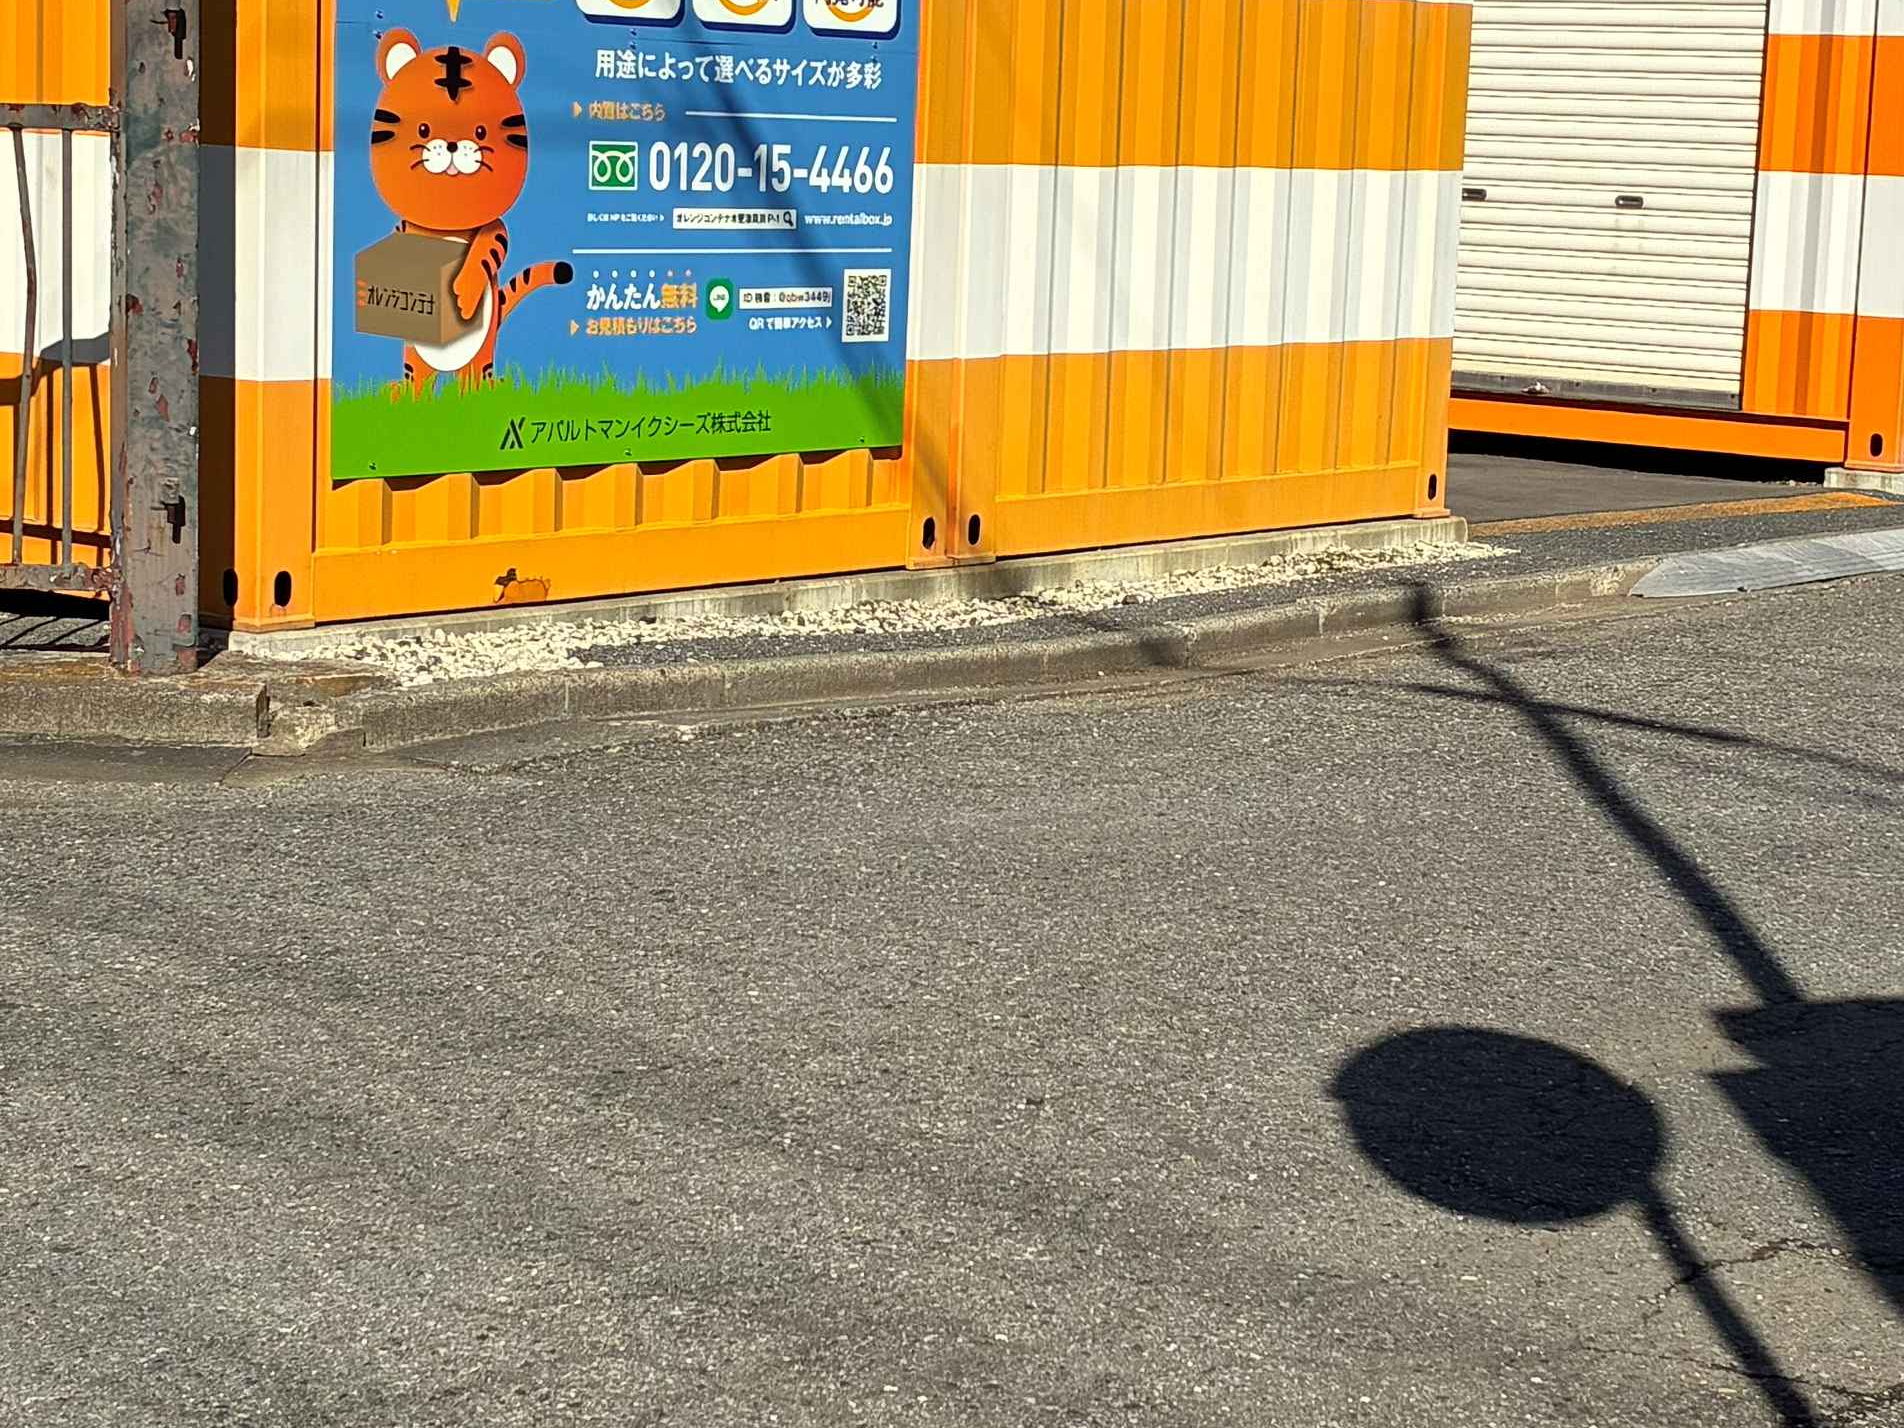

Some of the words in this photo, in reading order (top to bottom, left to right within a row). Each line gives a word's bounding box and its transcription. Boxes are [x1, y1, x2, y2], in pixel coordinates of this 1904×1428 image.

[594, 48, 883, 90] 用途によって選べるサイズが多彩
[648, 140, 895, 194] 0120-15-4466
[803, 213, 893, 227] www.rentalbox.jp
